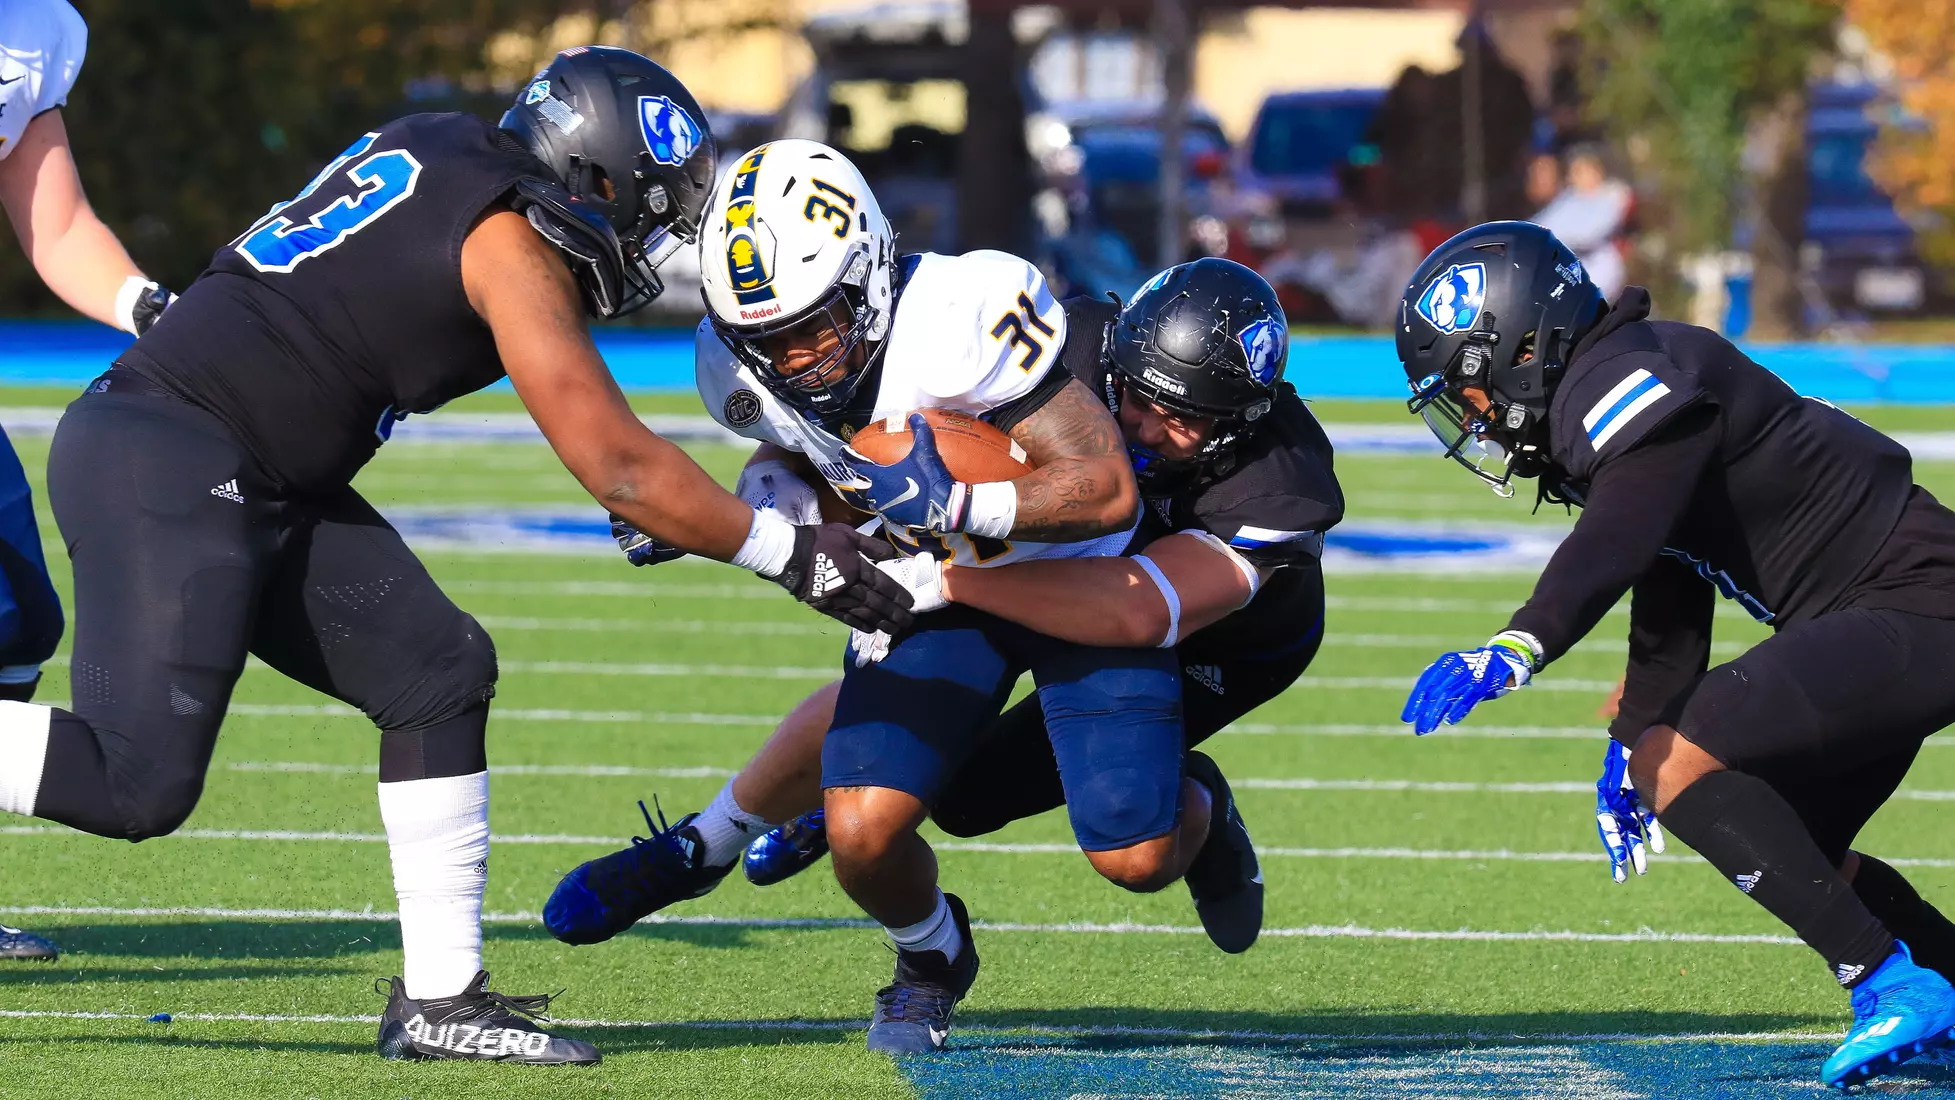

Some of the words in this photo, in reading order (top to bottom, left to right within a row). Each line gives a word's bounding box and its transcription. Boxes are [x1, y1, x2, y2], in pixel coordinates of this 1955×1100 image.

[228, 128, 423, 273] 3
[804, 178, 857, 240] 31
[740, 303, 782, 320] Riddell
[989, 290, 1057, 374] 31
[1143, 369, 1186, 395] Riddell
[812, 552, 827, 597] adidas
[1186, 665, 1224, 695] adidas
[1473, 650, 1493, 679] adidas
